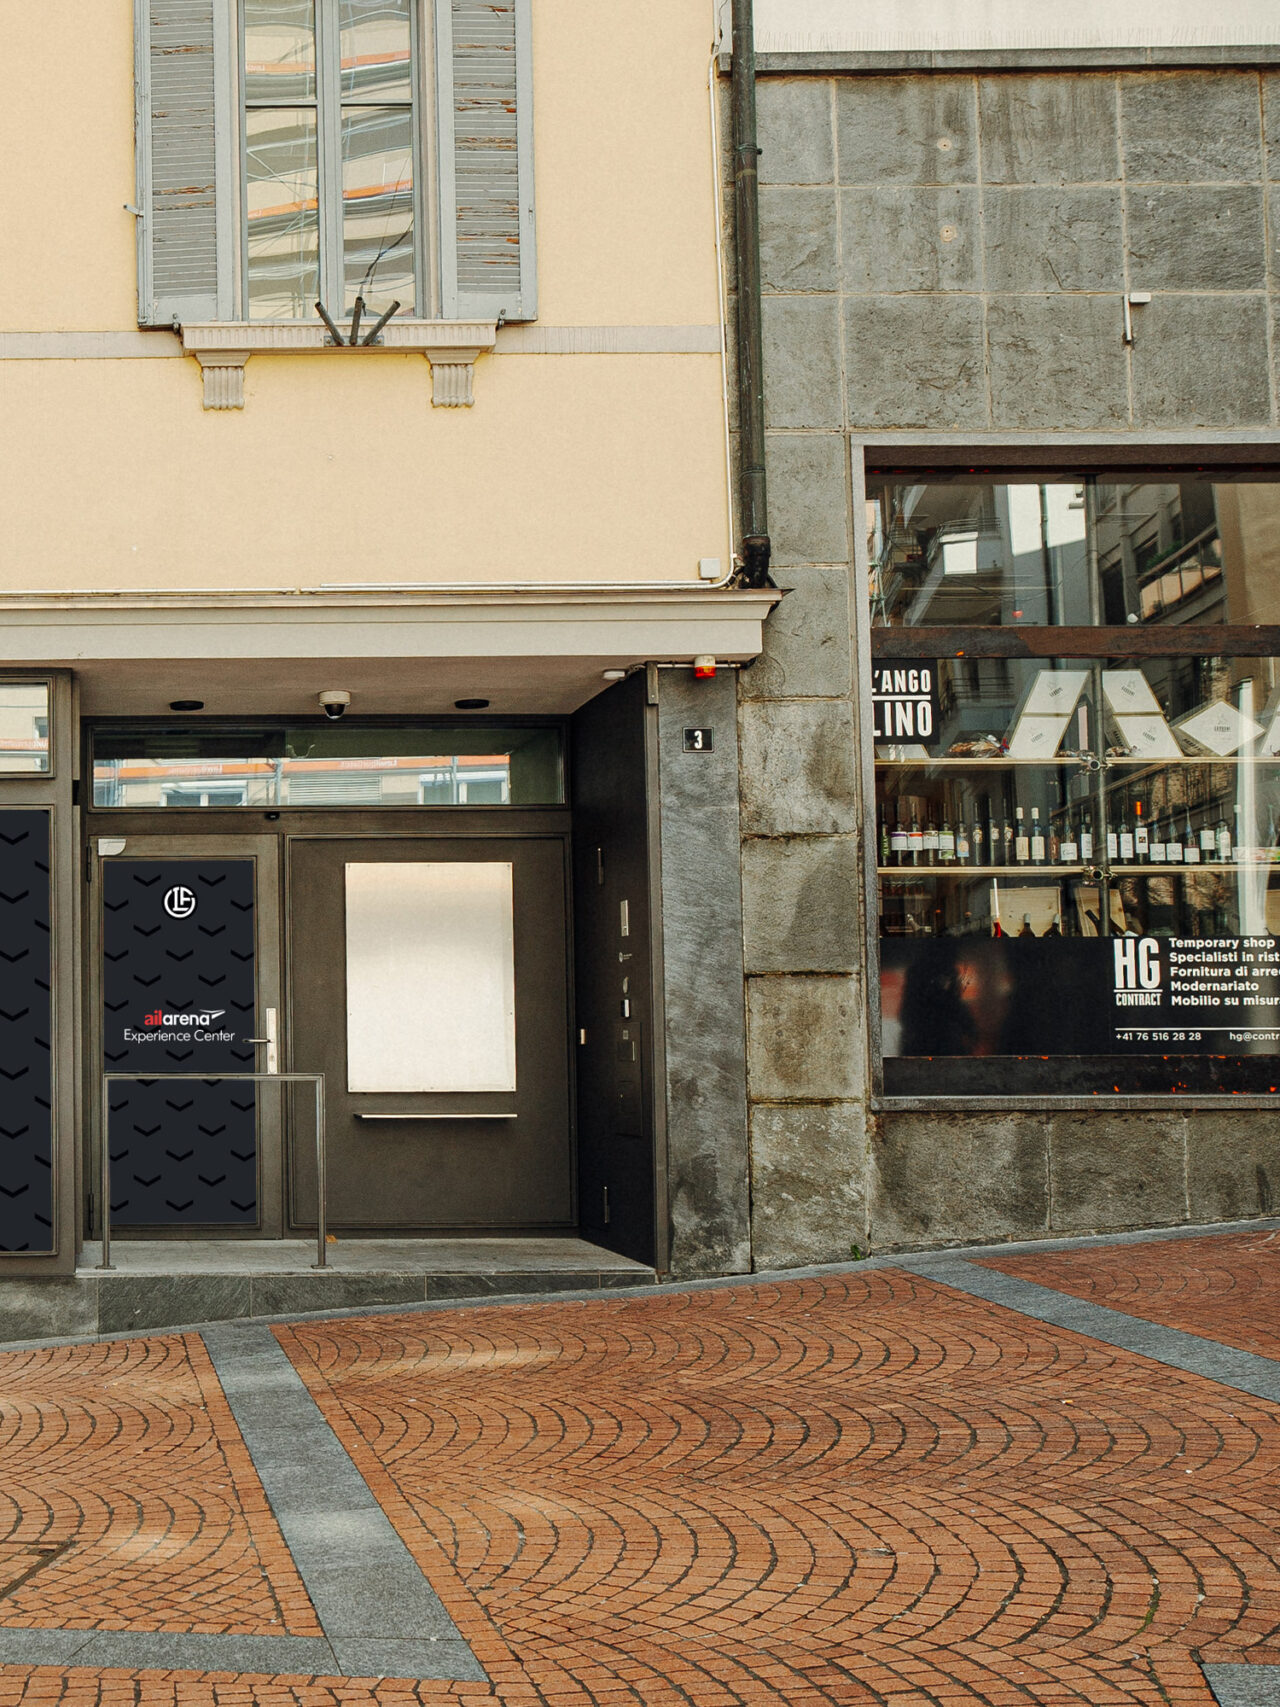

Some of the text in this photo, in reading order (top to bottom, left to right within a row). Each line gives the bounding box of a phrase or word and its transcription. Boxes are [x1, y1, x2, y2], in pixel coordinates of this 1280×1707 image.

[694, 730, 703, 749] 3
[1169, 937, 1276, 949] Temporary shop
[1113, 938, 1161, 989] HG
[1169, 952, 1238, 964] Specialisti
[1242, 951, 1254, 962] in
[1170, 966, 1280, 977] Fornitura di arre
[1170, 981, 1260, 991] Modernariato
[1115, 993, 1161, 1006] CONTRACT
[1171, 995, 1280, 1006] Mobilio su misur
[123, 1028, 236, 1044] Experience Center
[1116, 1032, 1202, 1041] +41 76 516 28 28
